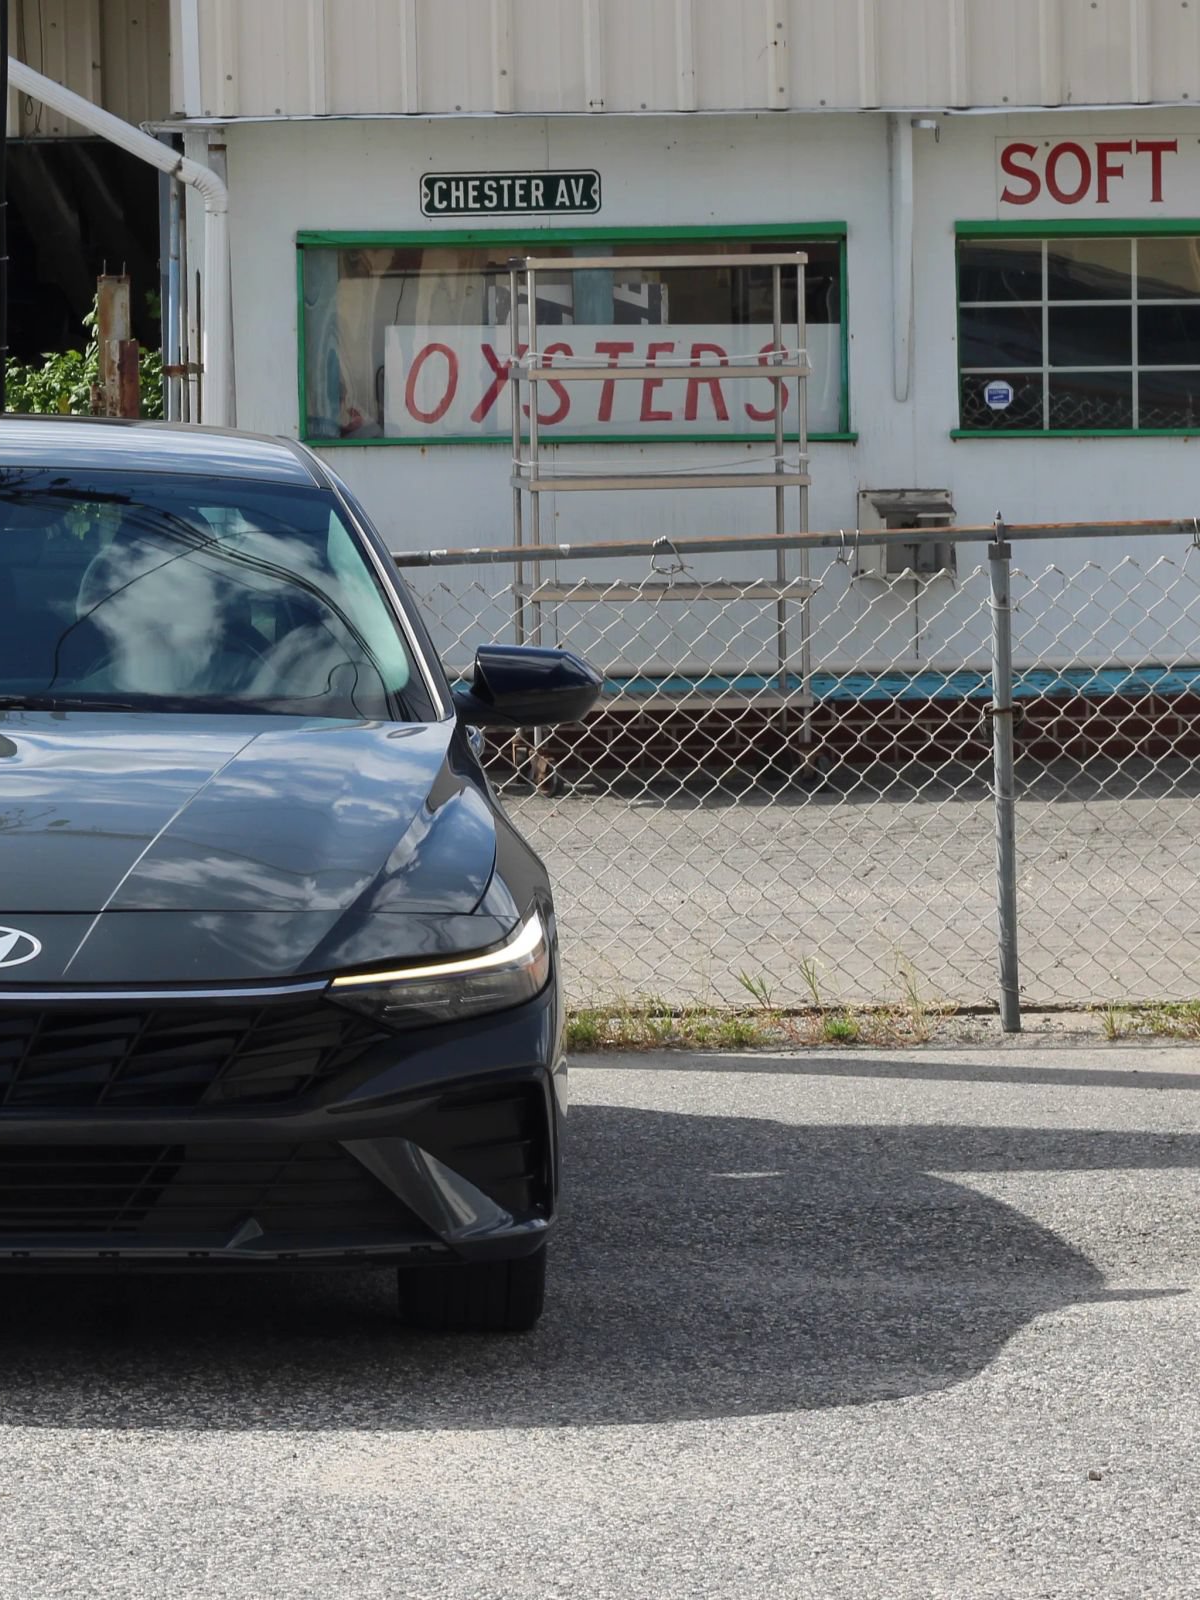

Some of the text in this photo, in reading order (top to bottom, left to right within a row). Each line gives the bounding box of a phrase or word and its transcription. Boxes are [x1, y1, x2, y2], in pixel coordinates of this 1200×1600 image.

[433, 177, 588, 210] CHESTER AV.
[1000, 138, 1178, 206] SOFT
[404, 341, 790, 426] OYSTERS
